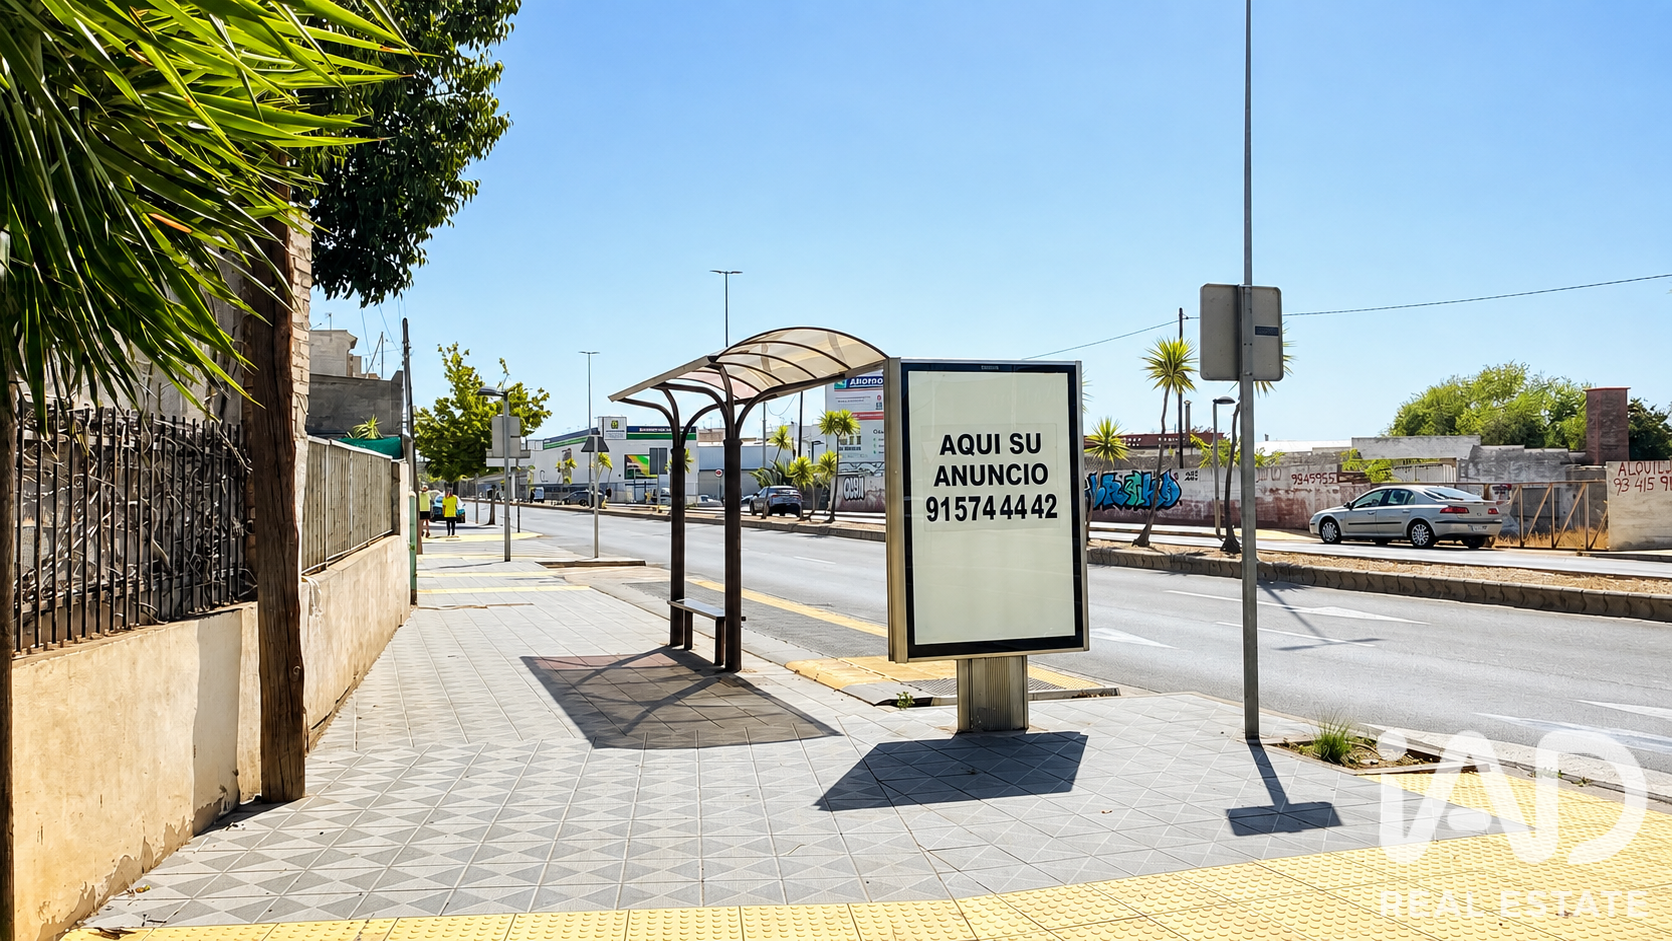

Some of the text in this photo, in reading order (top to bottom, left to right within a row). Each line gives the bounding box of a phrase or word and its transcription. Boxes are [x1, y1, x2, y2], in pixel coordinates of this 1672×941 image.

[939, 432, 1042, 456] AQUI SU
[933, 463, 1049, 487] ANUNCIO
[1613, 477, 1630, 496] 93
[1634, 476, 1656, 493] 415
